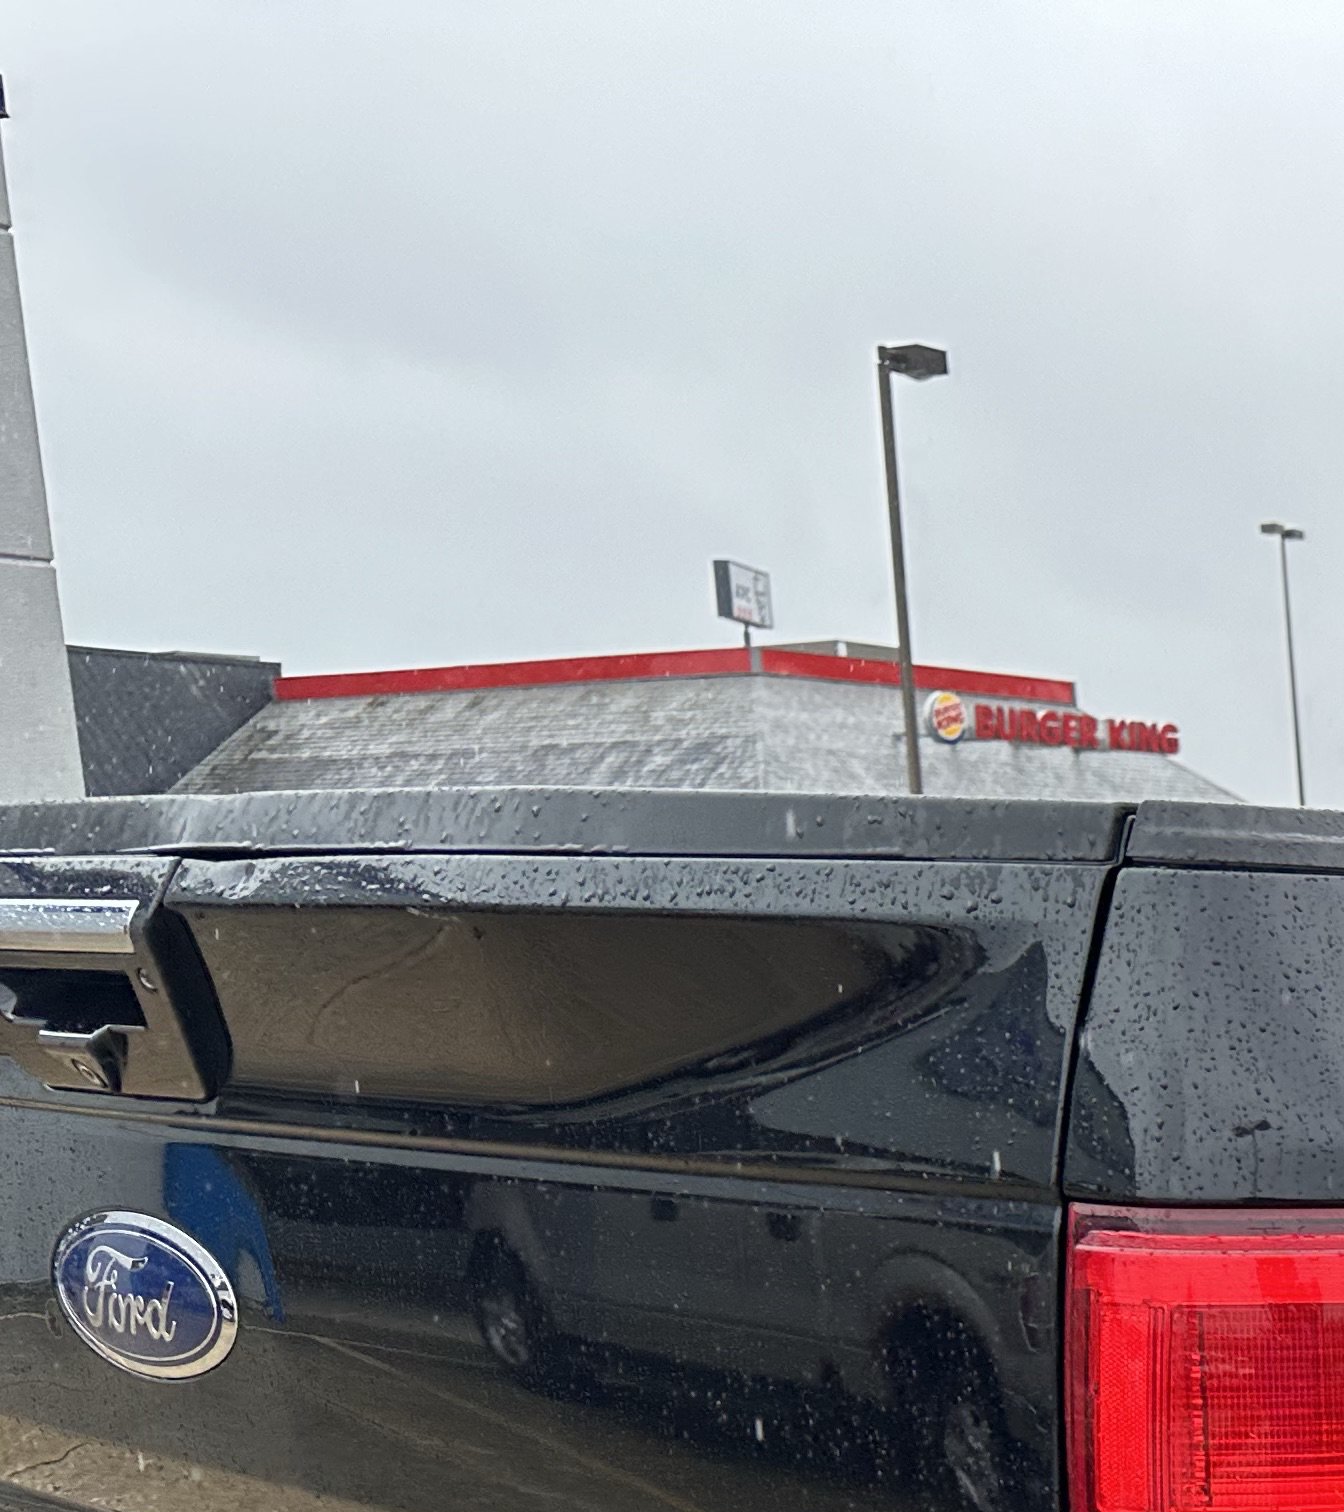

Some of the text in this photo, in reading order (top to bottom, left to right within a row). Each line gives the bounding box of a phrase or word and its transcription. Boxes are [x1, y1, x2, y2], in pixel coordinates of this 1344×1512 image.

[975, 704, 1100, 748] BURGER
[1108, 719, 1180, 754] KING
[83, 1245, 177, 1342] Ford
